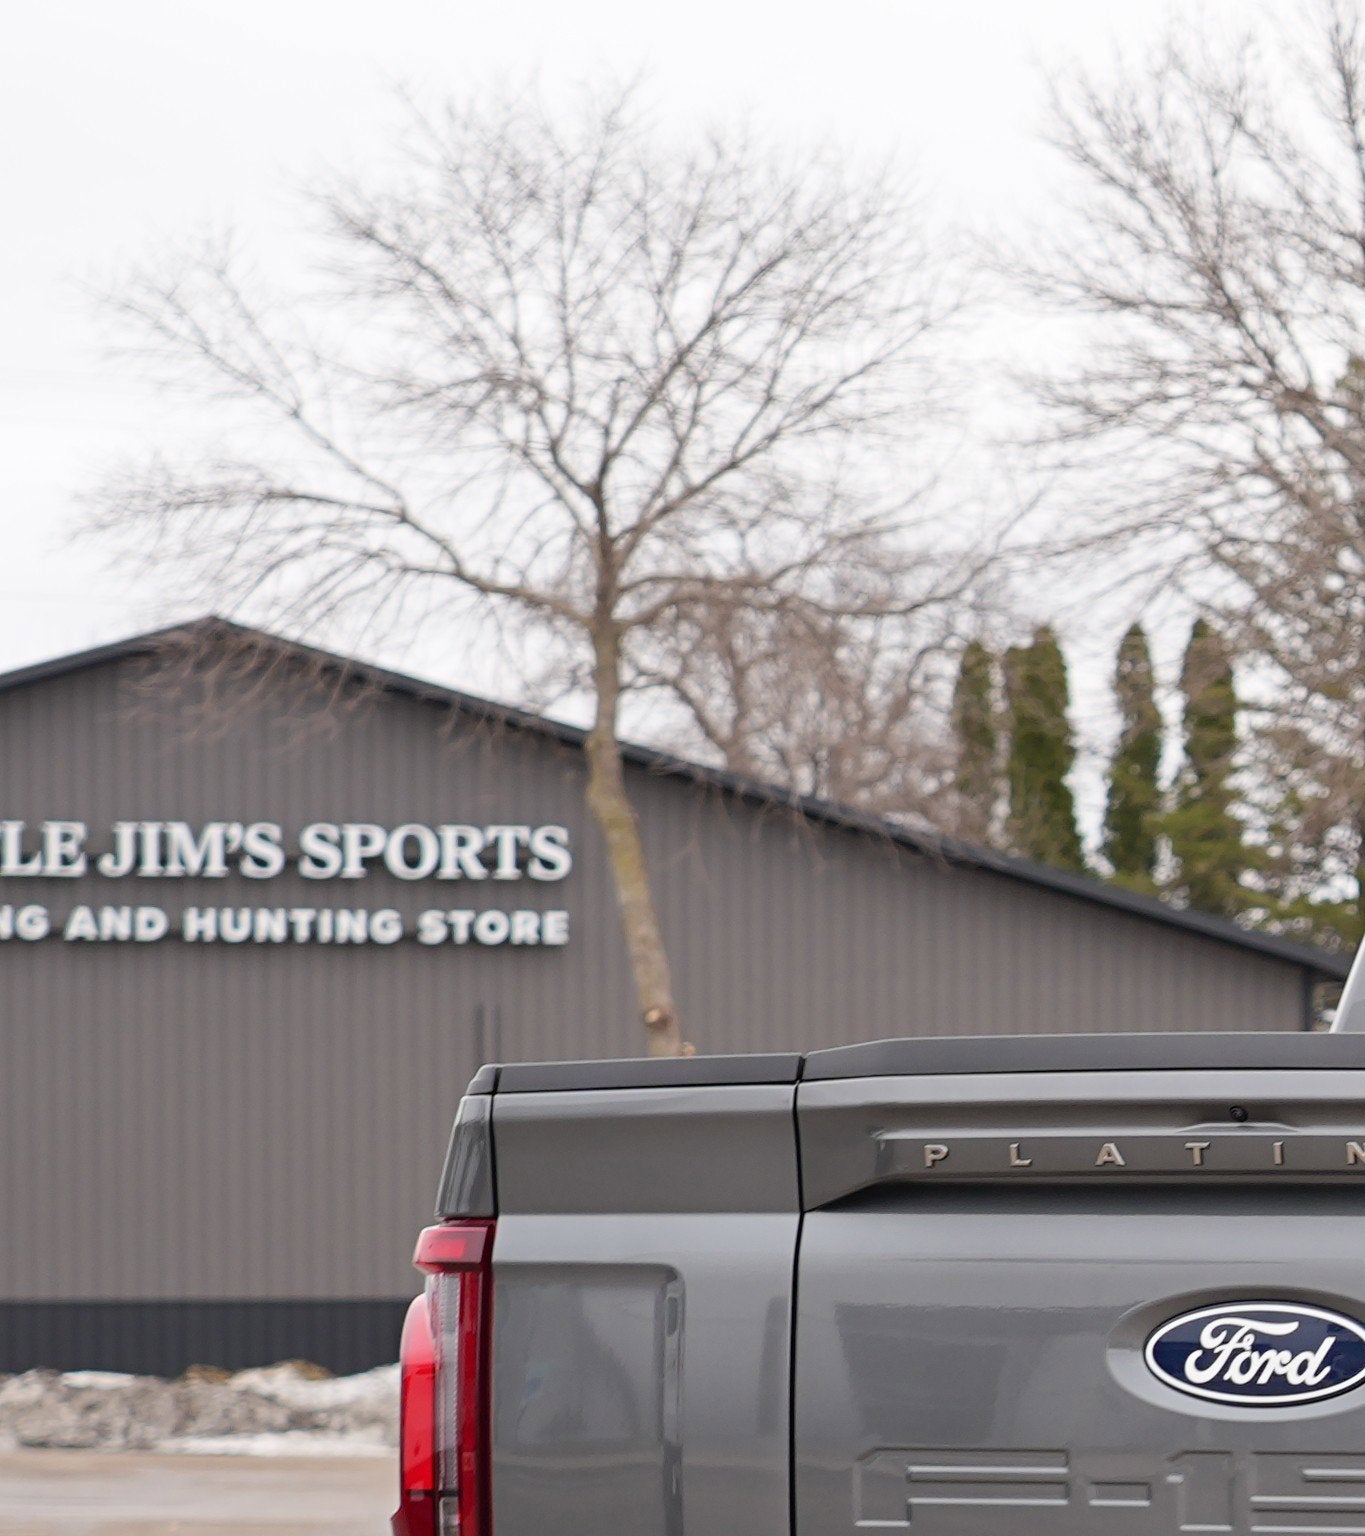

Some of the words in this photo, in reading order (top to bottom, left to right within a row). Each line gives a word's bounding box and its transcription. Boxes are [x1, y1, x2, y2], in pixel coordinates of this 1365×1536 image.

[100, 821, 285, 879] JIM'S
[299, 823, 572, 881] SPORTS
[63, 905, 170, 942] AND
[183, 906, 403, 944] HUNTING
[417, 909, 570, 946] STORE
[1182, 1315, 1338, 1387] Ford
